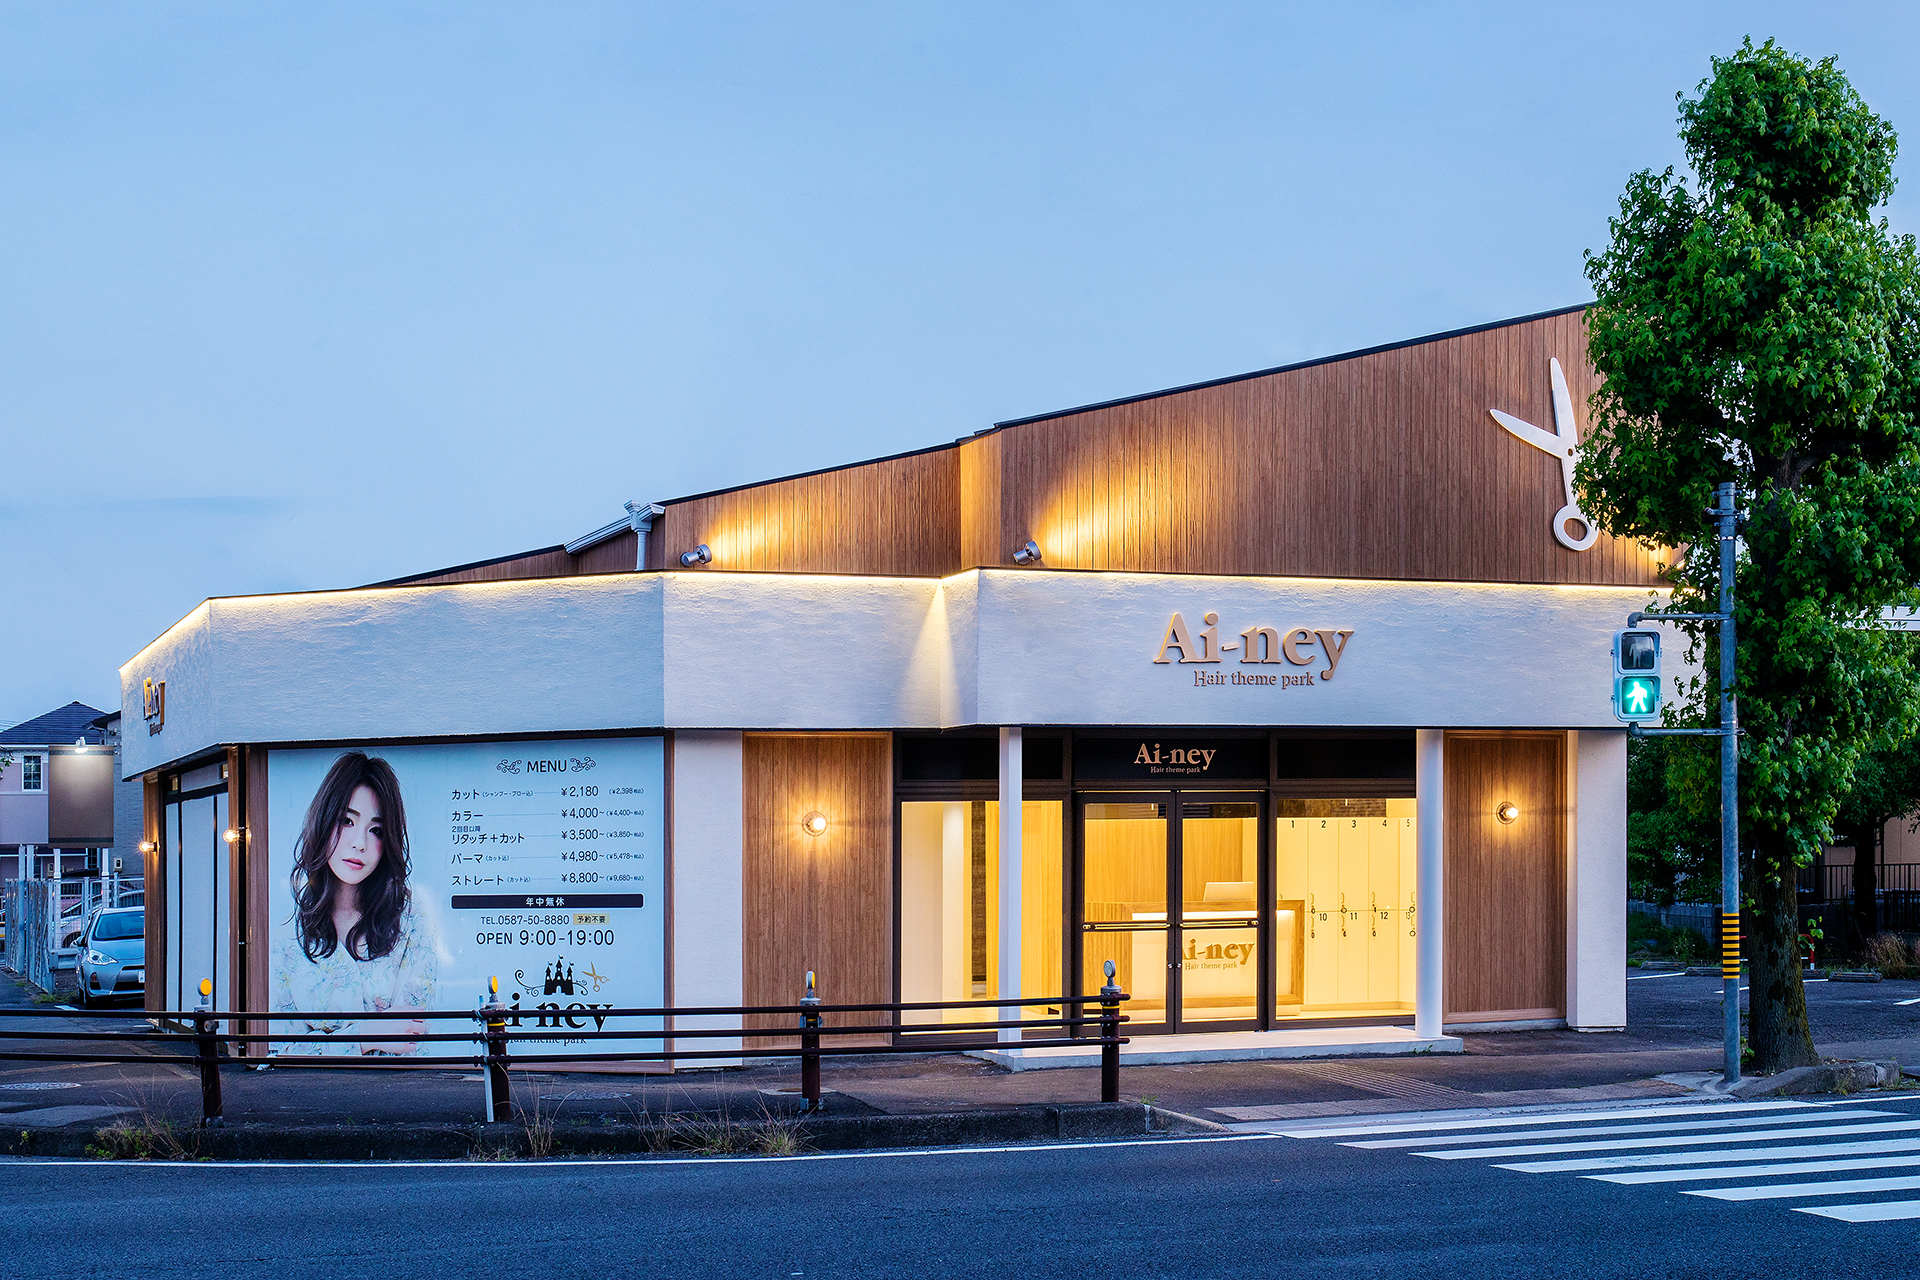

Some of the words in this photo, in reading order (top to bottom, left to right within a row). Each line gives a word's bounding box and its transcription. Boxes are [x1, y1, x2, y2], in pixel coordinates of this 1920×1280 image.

[1153, 612, 1355, 680] Ai-ney
[1194, 670, 1227, 687] Hair
[1231, 670, 1278, 686] theme
[1282, 671, 1315, 689] park
[1134, 743, 1217, 771] Ai-ney
[526, 759, 568, 773] MENU
[1150, 766, 1165, 774] Hair
[1165, 766, 1186, 774] theme
[1186, 766, 1201, 775] park
[452, 788, 480, 801] カット
[561, 785, 599, 798] ¥2,180
[452, 810, 484, 822] カラー
[1291, 820, 1295, 828] 1
[1321, 820, 1327, 829] 2
[1351, 820, 1357, 829] 3
[1382, 819, 1387, 828] 4
[1406, 819, 1411, 828] 5
[451, 852, 484, 865] パーマ
[451, 874, 505, 886] ストレート
[525, 896, 566, 907] 年中無休
[480, 914, 570, 926] TEL.0587-50-8880
[1319, 913, 1328, 921] 10
[1350, 912, 1358, 920] 11
[1380, 911, 1389, 920] 12
[476, 932, 513, 945] OPEN
[519, 929, 615, 946] 9:00-19:00
[1222, 961, 1238, 970] park
[479, 992, 614, 1032] iney
